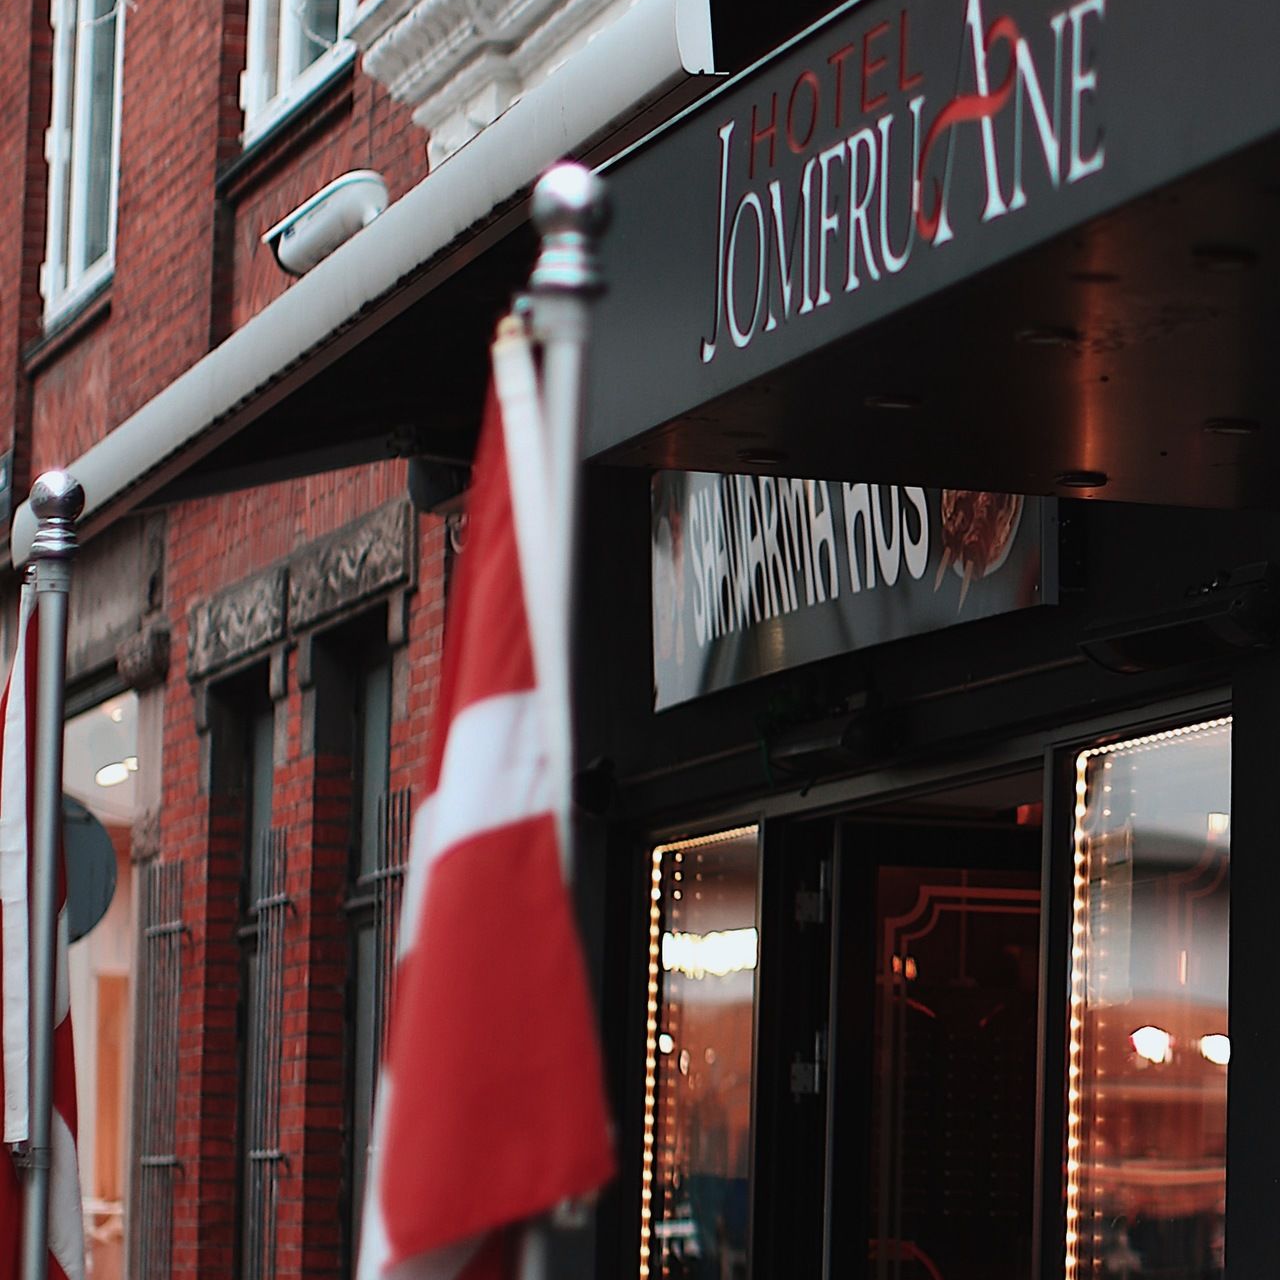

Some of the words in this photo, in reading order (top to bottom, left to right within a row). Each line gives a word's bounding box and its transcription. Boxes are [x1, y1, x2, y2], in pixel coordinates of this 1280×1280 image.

[747, 9, 926, 182] HOTEL
[688, 475, 840, 648] SHAWARMA
[843, 483, 930, 593] HUS
